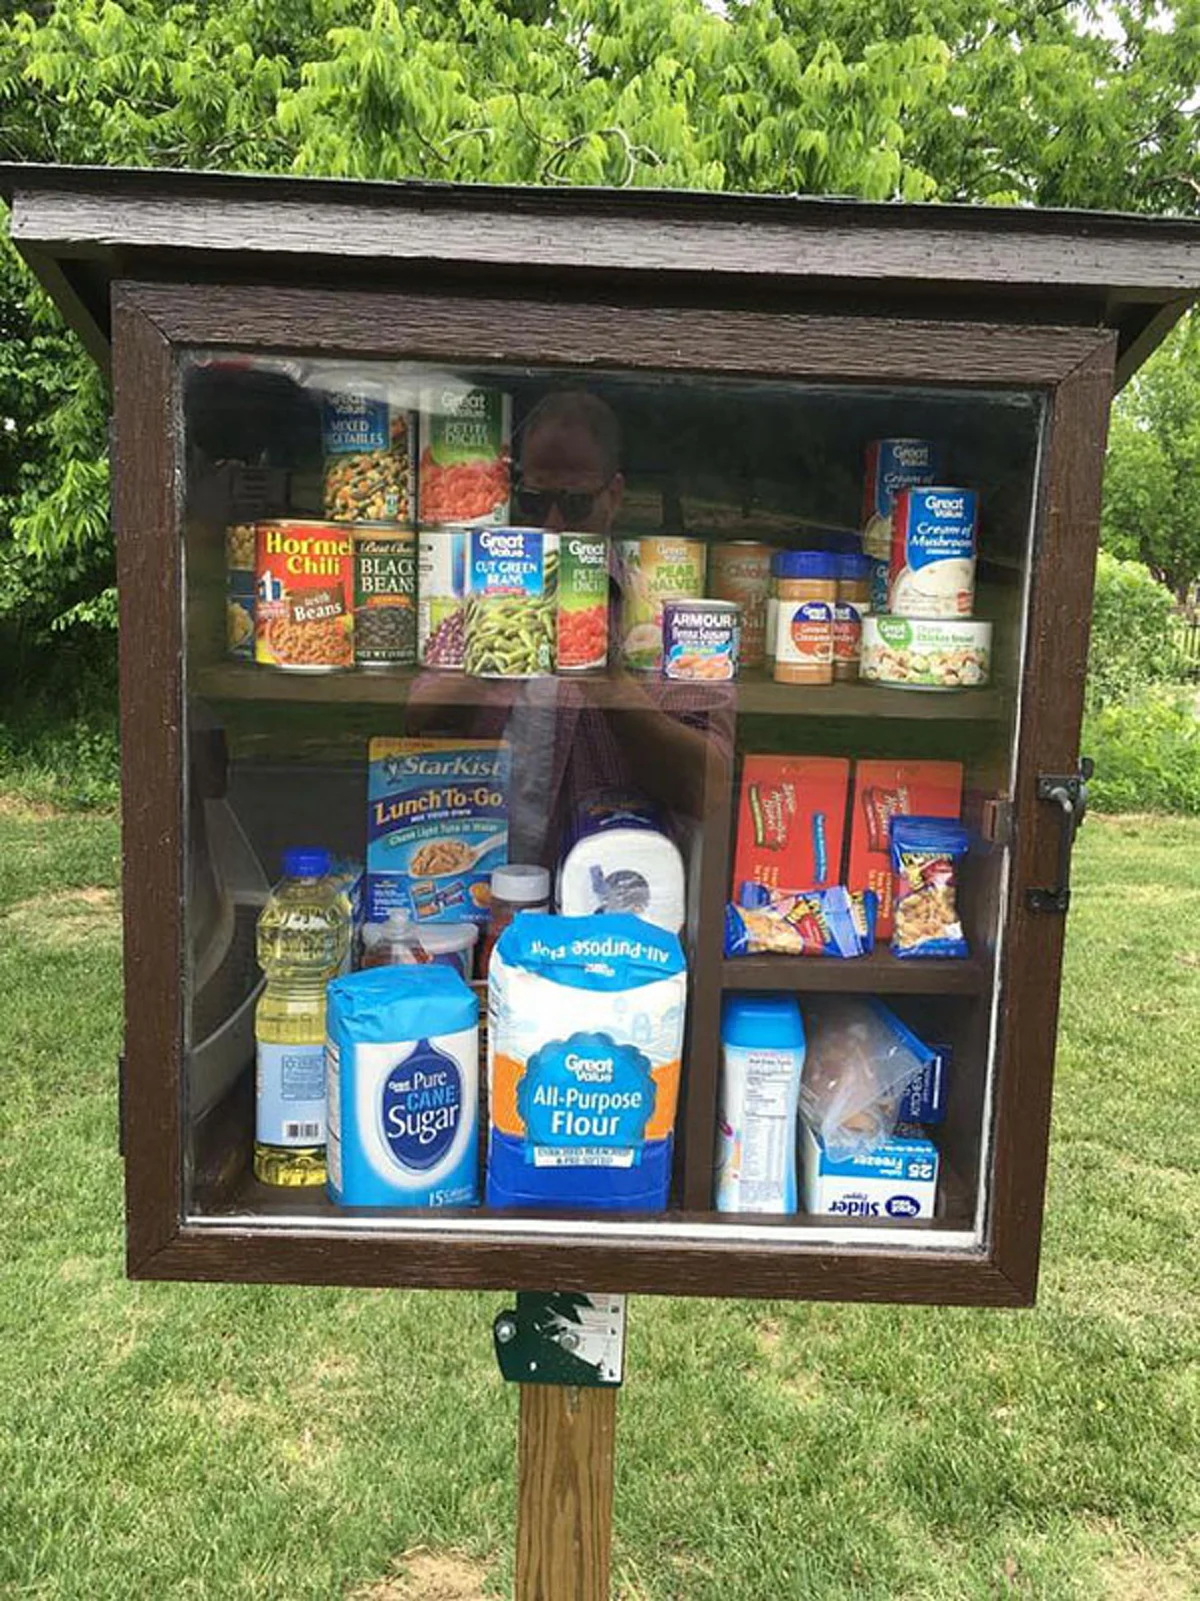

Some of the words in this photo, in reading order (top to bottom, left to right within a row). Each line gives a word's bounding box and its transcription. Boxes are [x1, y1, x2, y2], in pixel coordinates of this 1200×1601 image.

[442, 390, 485, 407] Great
[893, 446, 928, 459] Great
[925, 495, 964, 509] Great
[933, 508, 963, 518] Value
[917, 522, 960, 534] Cream
[961, 524, 973, 537] of
[480, 533, 523, 548] Great
[569, 540, 605, 555] Great
[910, 536, 972, 547] Mushroom
[489, 546, 524, 557] Value
[287, 555, 339, 575] Chili
[476, 561, 496, 573] CUT
[498, 561, 537, 572] GREEN
[656, 565, 695, 577] PEAR
[487, 572, 524, 584] BEANS
[650, 578, 698, 590] HALVES
[294, 602, 343, 622] Beans
[672, 612, 732, 628] ARMOUR
[881, 622, 905, 634] Great
[404, 756, 500, 776] StarKist
[374, 790, 440, 825] Lunch
[441, 787, 503, 808] To-Go
[417, 825, 440, 837] Light
[571, 937, 670, 963] All-Purpose
[565, 1054, 613, 1072] Great
[414, 1071, 447, 1089] Pure
[576, 1071, 612, 1082] Value
[406, 1085, 455, 1111] CANE
[533, 1085, 642, 1114] All-Purpose
[388, 1104, 459, 1144] Sugar
[552, 1111, 620, 1135] Flour
[853, 1156, 903, 1169] Freezer
[908, 1164, 932, 1178] 25
[429, 1190, 443, 1208] 15
[829, 1201, 880, 1216] Slider
